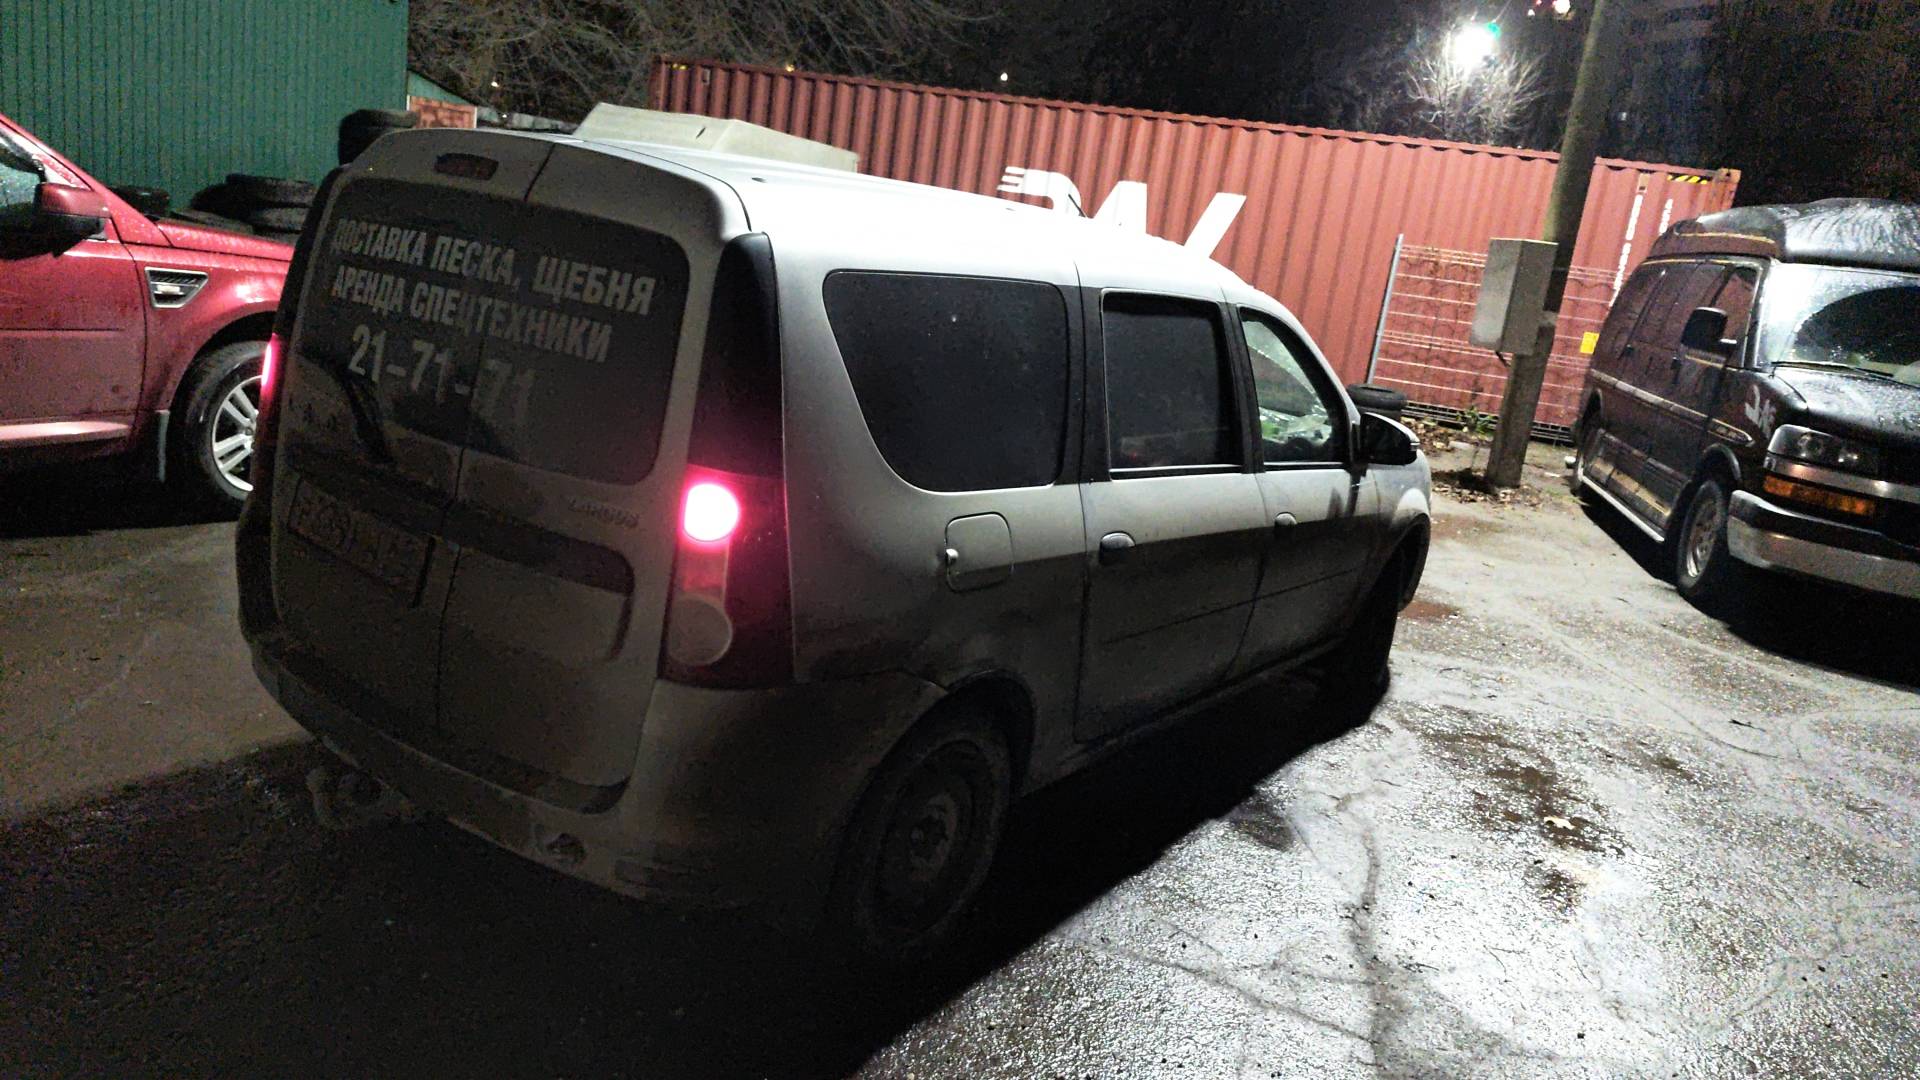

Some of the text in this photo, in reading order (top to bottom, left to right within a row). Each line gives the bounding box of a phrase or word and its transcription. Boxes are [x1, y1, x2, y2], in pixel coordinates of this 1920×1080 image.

[330, 218, 656, 316] ДОСТАВКА ПЕСКА, ЩЕБНЯ
[331, 264, 613, 363] АРЕНДА СПЕЦТЕХНИКИ
